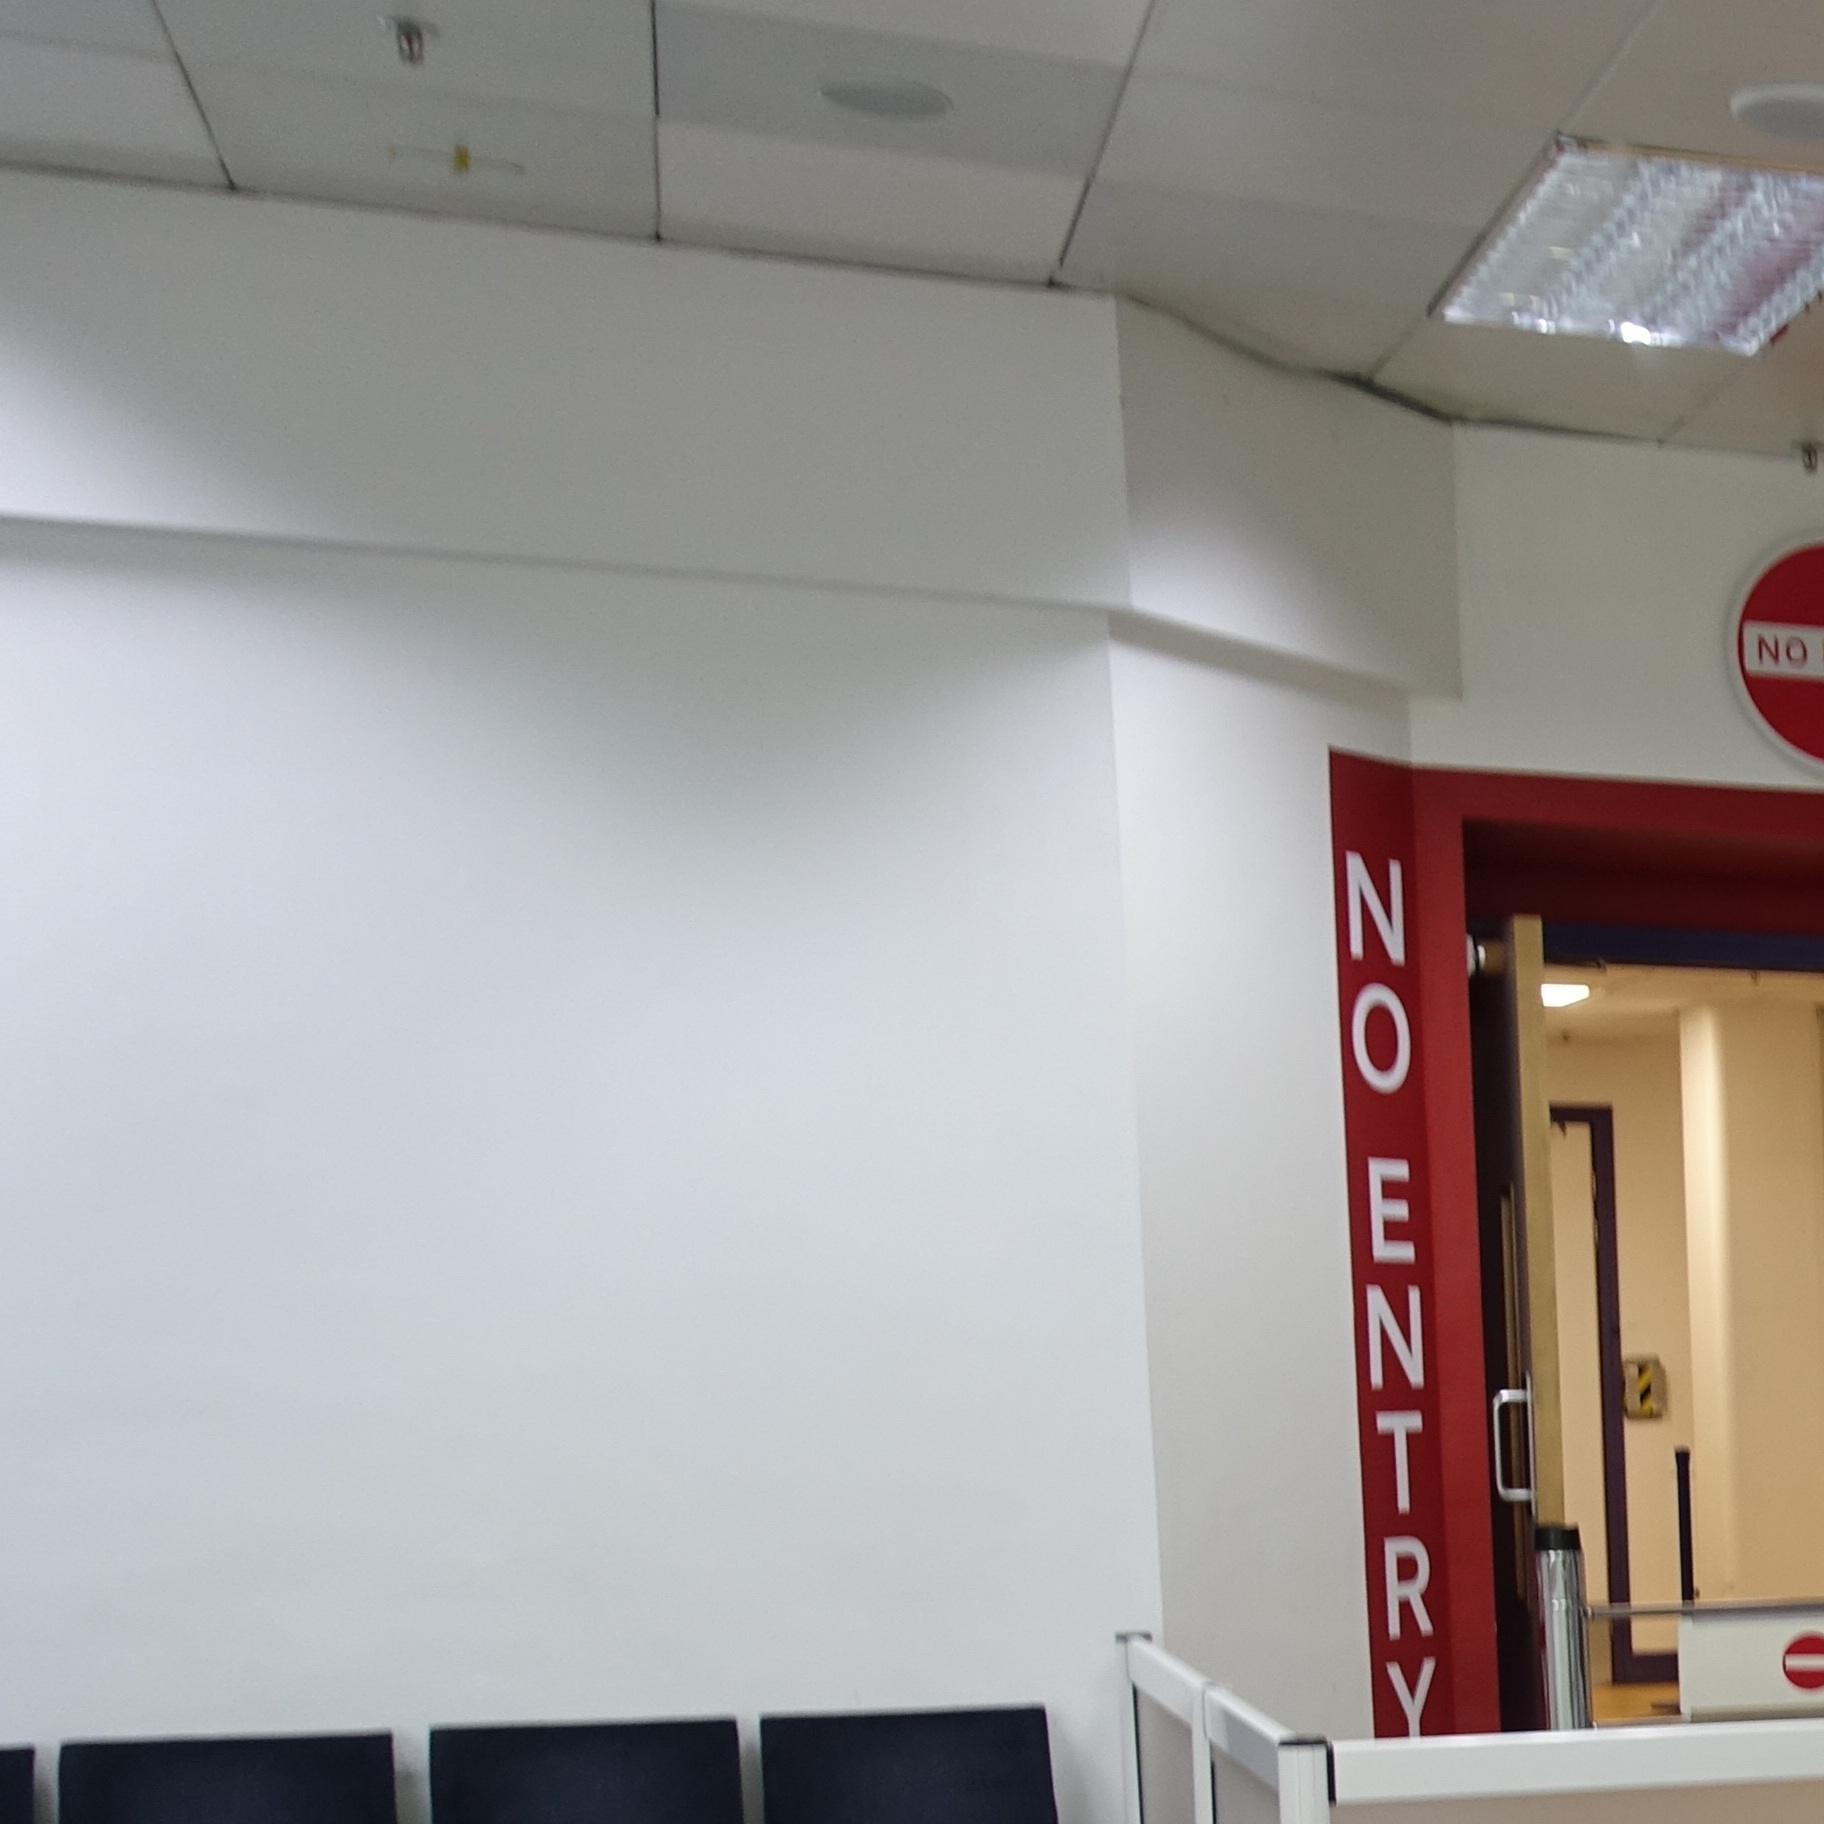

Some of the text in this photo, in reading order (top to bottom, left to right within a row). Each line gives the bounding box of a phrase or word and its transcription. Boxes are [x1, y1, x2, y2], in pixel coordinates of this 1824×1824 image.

[1757, 634, 1808, 669] NO
[1345, 850, 1437, 1738] NO ENTRY
